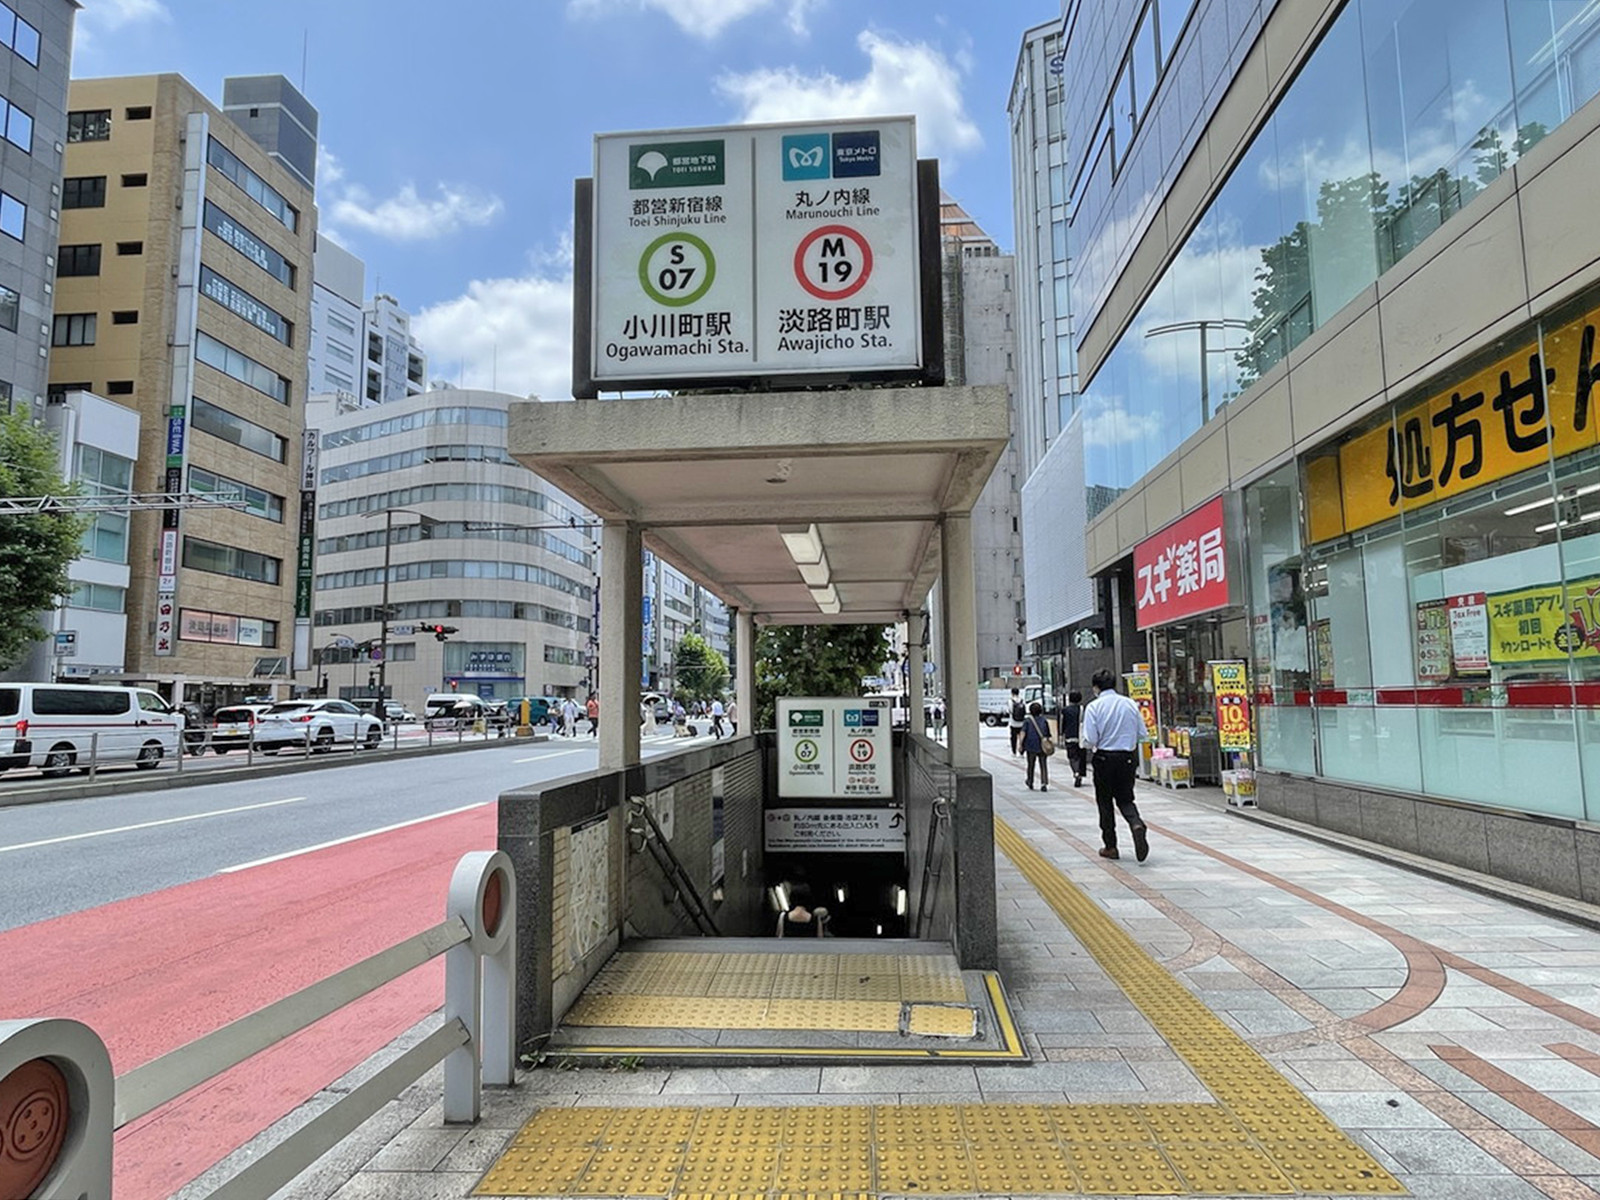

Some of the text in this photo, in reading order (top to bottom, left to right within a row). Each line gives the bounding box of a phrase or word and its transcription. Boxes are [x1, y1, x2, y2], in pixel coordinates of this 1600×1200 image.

[836, 146, 877, 156] 東京メトロ
[689, 164, 716, 173] SUBWAY
[632, 194, 724, 216] 都営新宿線
[795, 188, 871, 208] 丸ノ内線
[628, 212, 727, 228] Toei Shinjuku Line
[785, 205, 880, 221] Marunouchi Line
[670, 244, 684, 265] S
[820, 238, 846, 258] M
[658, 267, 696, 291] 07
[818, 261, 853, 284] 19
[622, 312, 733, 340] 小川町駅
[777, 305, 891, 334] 淡路町駅
[605, 338, 749, 361] Ogawamachi Sta.
[777, 333, 893, 354] Awajicho Sta.
[171, 417, 183, 455] SEIWA
[1137, 527, 1226, 610] スギ薬局
[1453, 608, 1481, 619] Tax Free
[800, 750, 812, 758] 07
